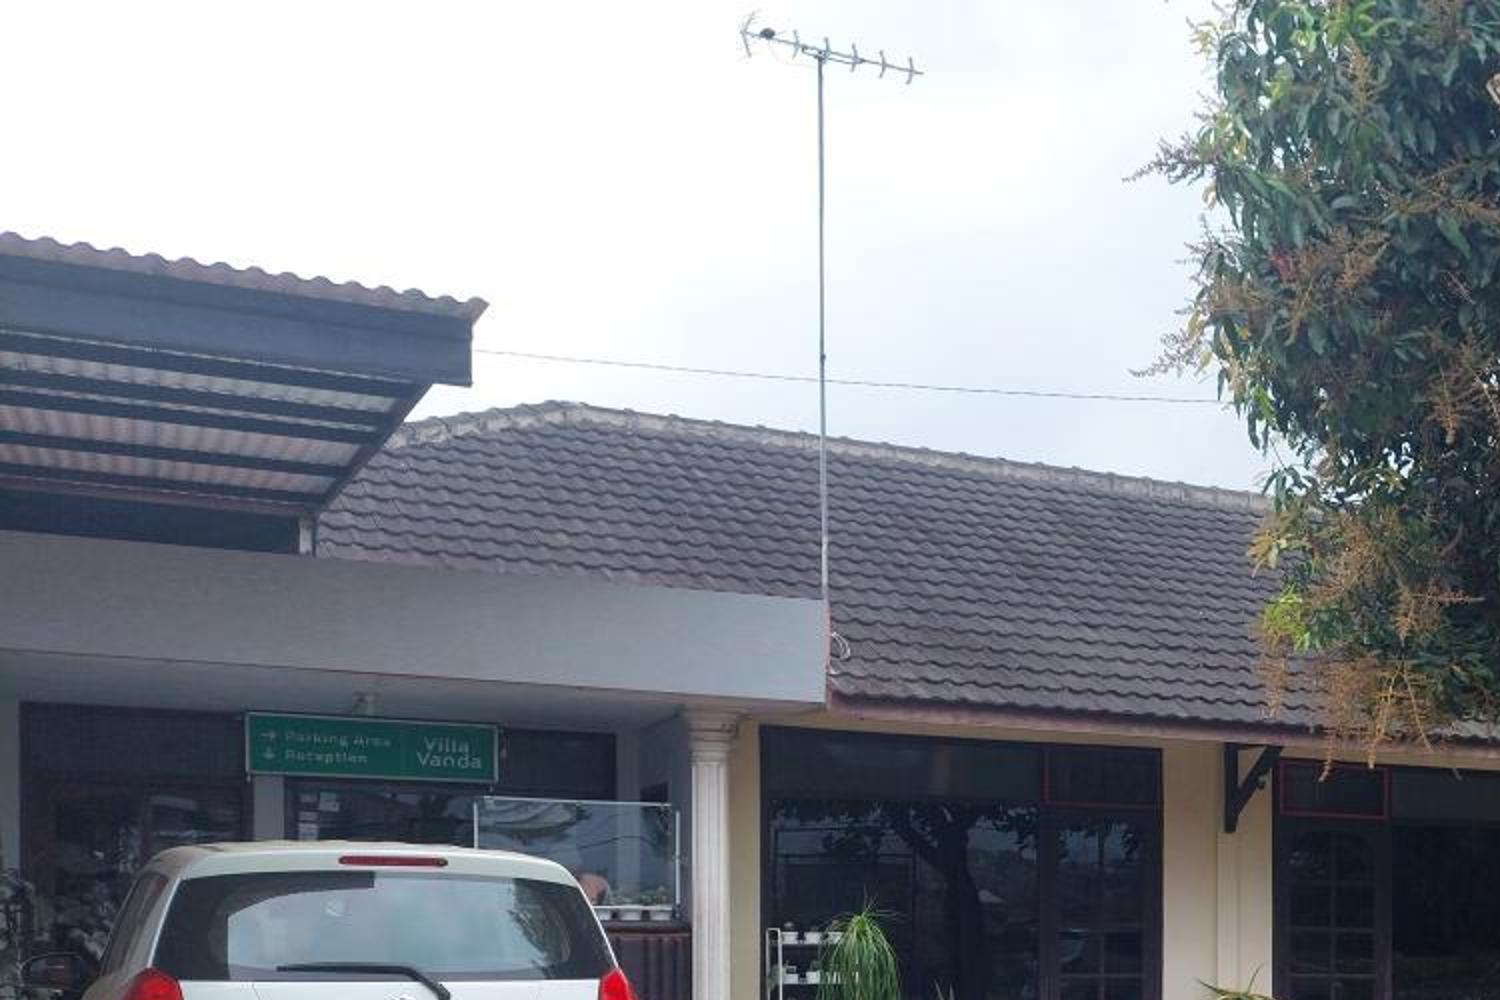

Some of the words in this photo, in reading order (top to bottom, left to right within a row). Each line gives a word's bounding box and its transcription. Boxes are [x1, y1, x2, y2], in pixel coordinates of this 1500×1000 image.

[285, 730, 349, 748] Parking
[423, 736, 469, 754] Villa
[285, 749, 368, 764] Reception
[416, 752, 482, 769] Vanda
